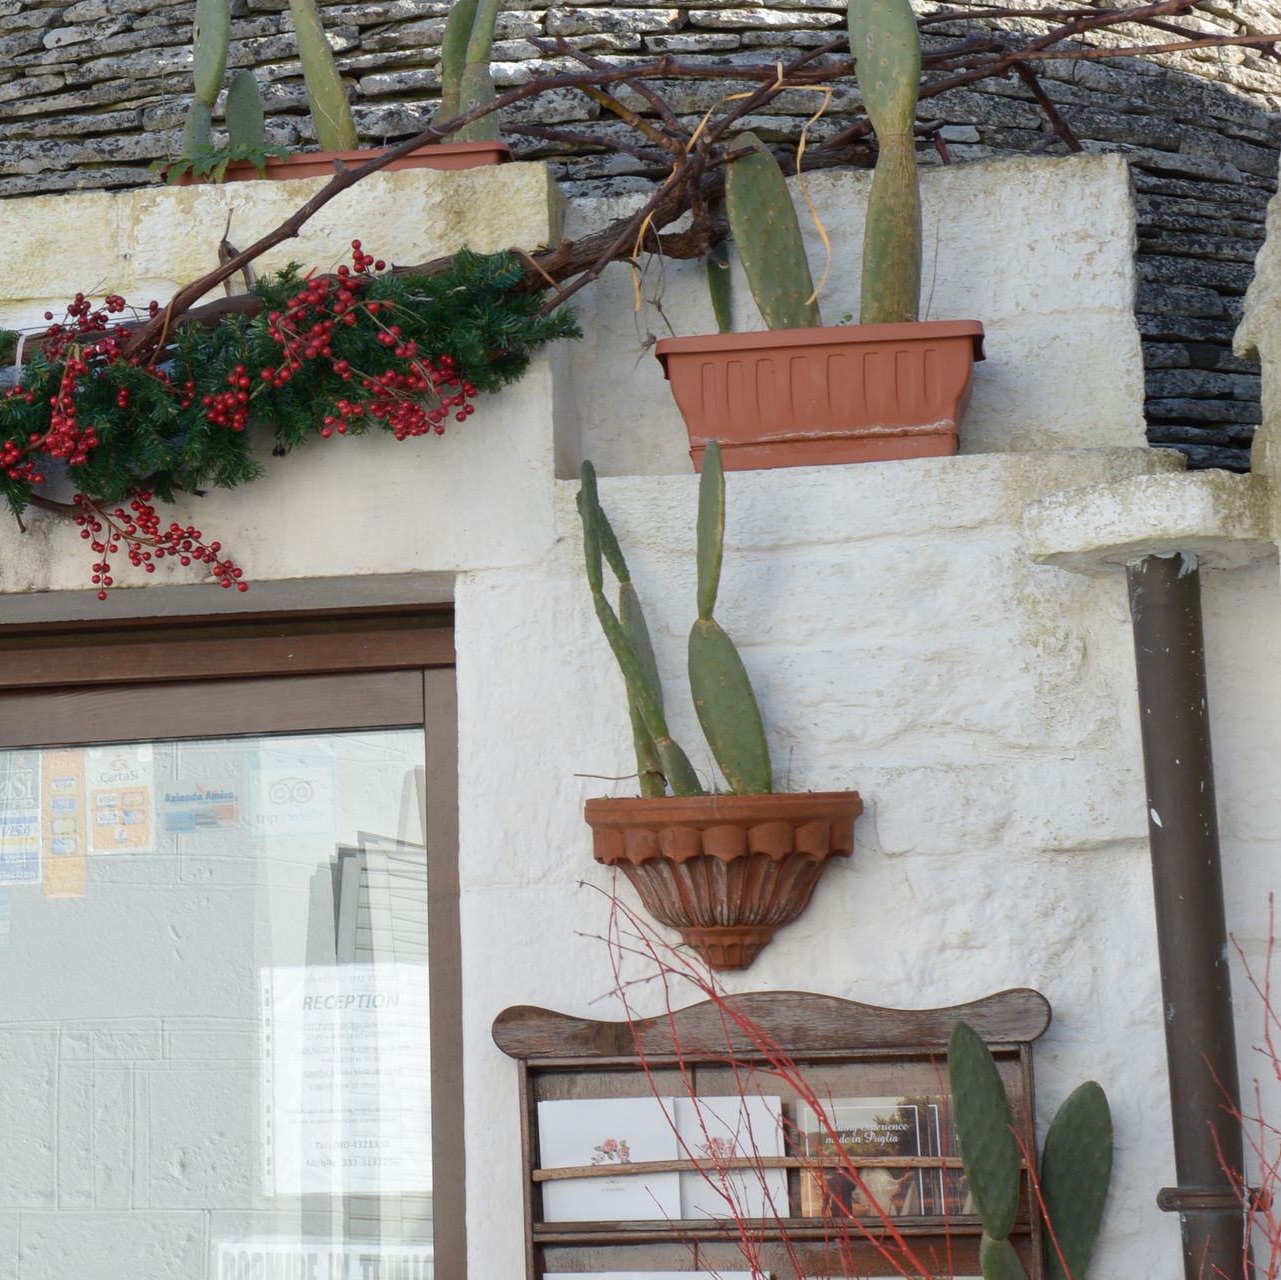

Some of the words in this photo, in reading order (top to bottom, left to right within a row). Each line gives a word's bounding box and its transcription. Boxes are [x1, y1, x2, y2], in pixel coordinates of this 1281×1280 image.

[302, 993, 400, 1010] RECEPTION
[826, 1133, 850, 1144] mde
[864, 1131, 899, 1146] Puglia
